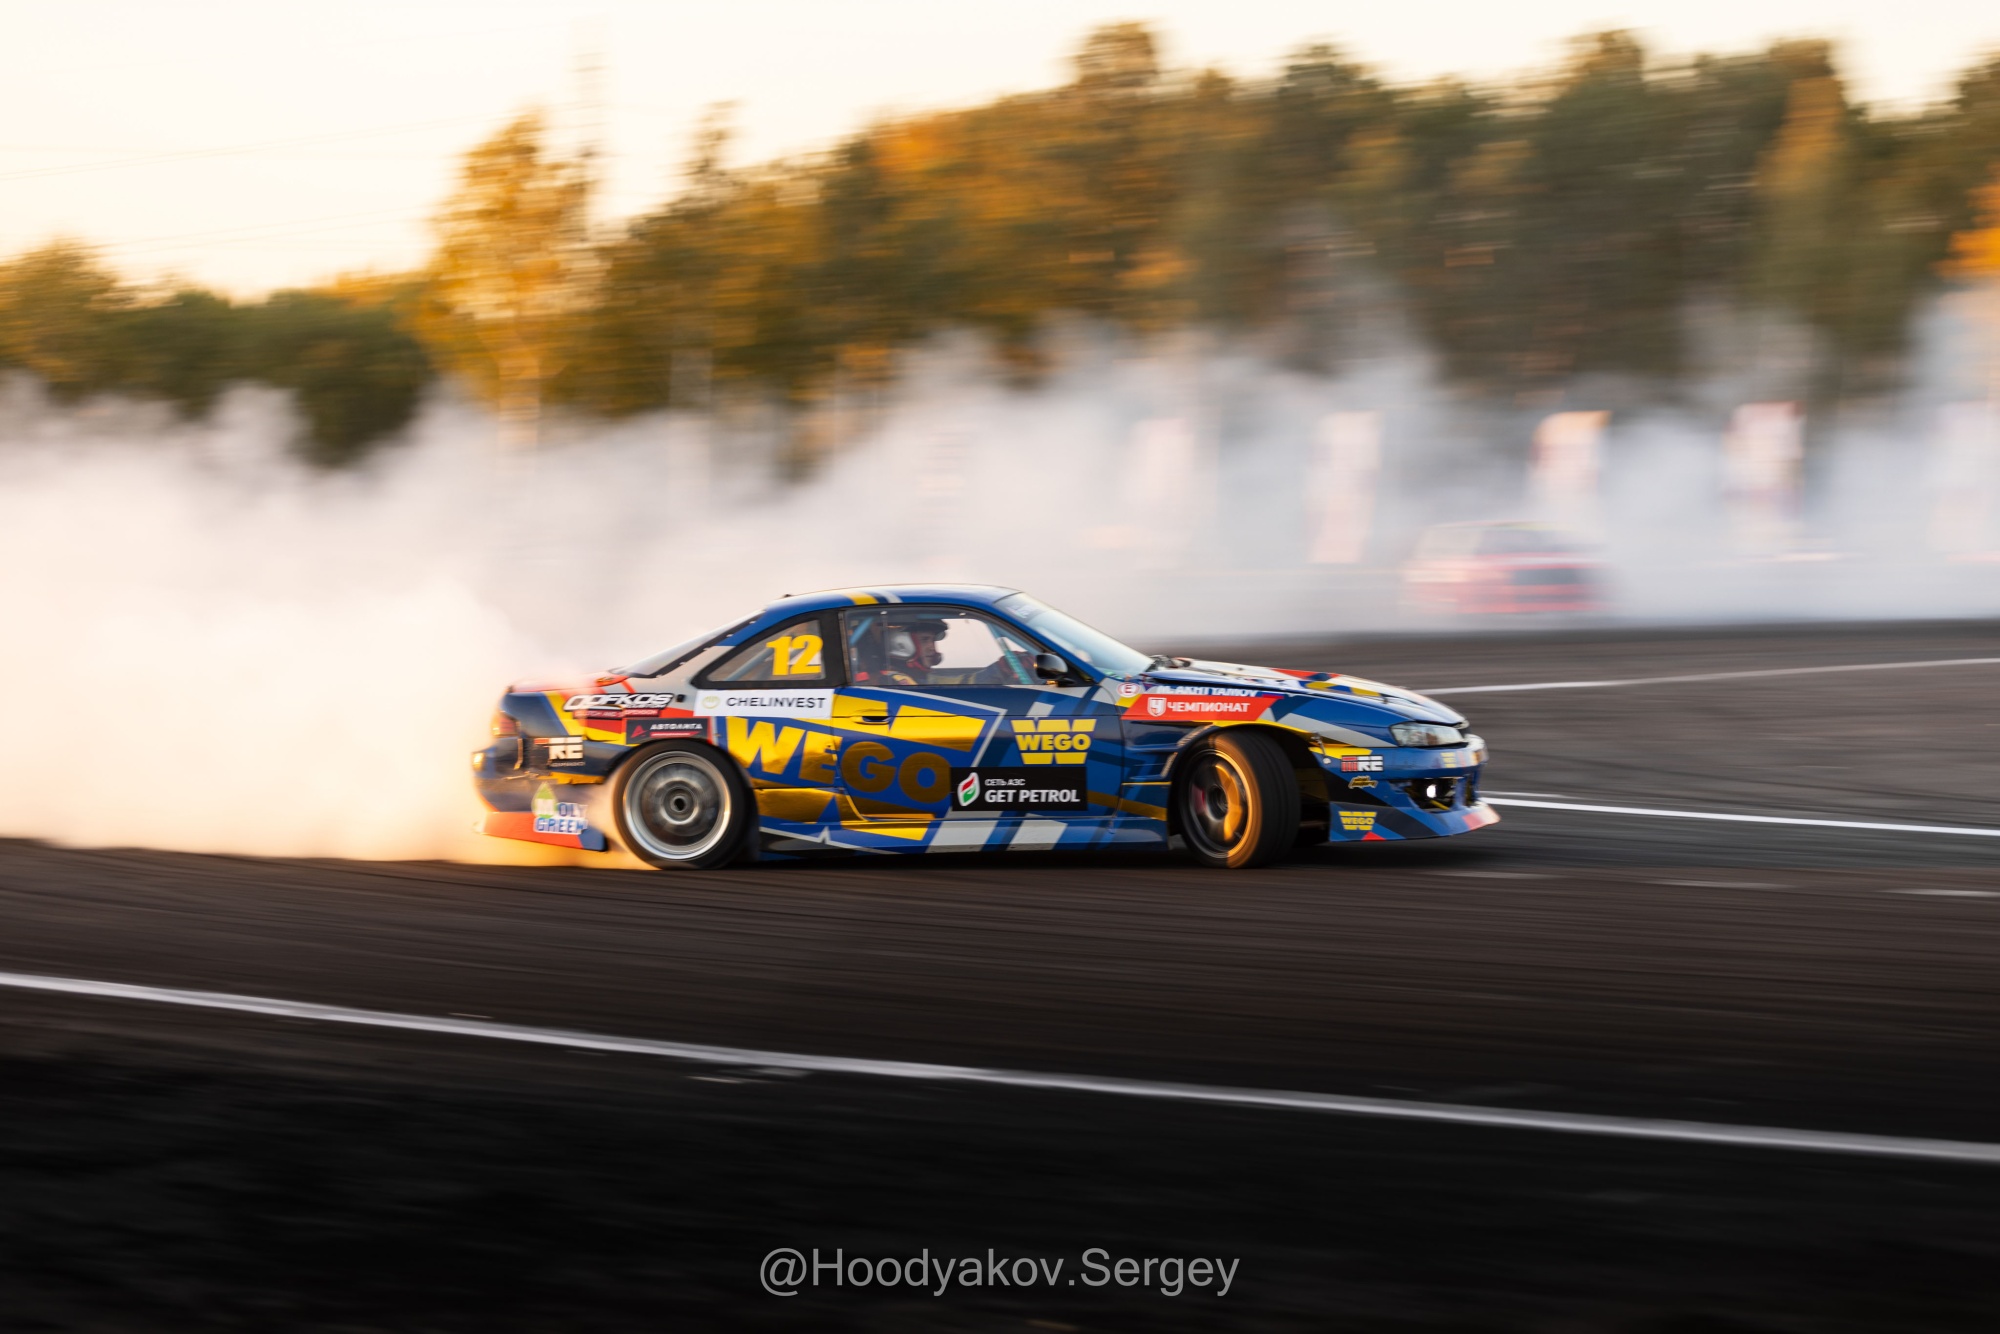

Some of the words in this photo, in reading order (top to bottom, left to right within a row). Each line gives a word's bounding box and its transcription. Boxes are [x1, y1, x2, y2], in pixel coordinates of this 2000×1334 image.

[766, 634, 823, 676] 12
[726, 697, 826, 709] CHELINVEST
[1167, 702, 1251, 713] ЧЕМПИОНАТ
[1015, 734, 1091, 751] WEGO
[726, 716, 952, 803] WEGO
[984, 789, 1017, 803] GET
[1018, 789, 1080, 803] PETROL
[1341, 817, 1375, 825] WEGO
